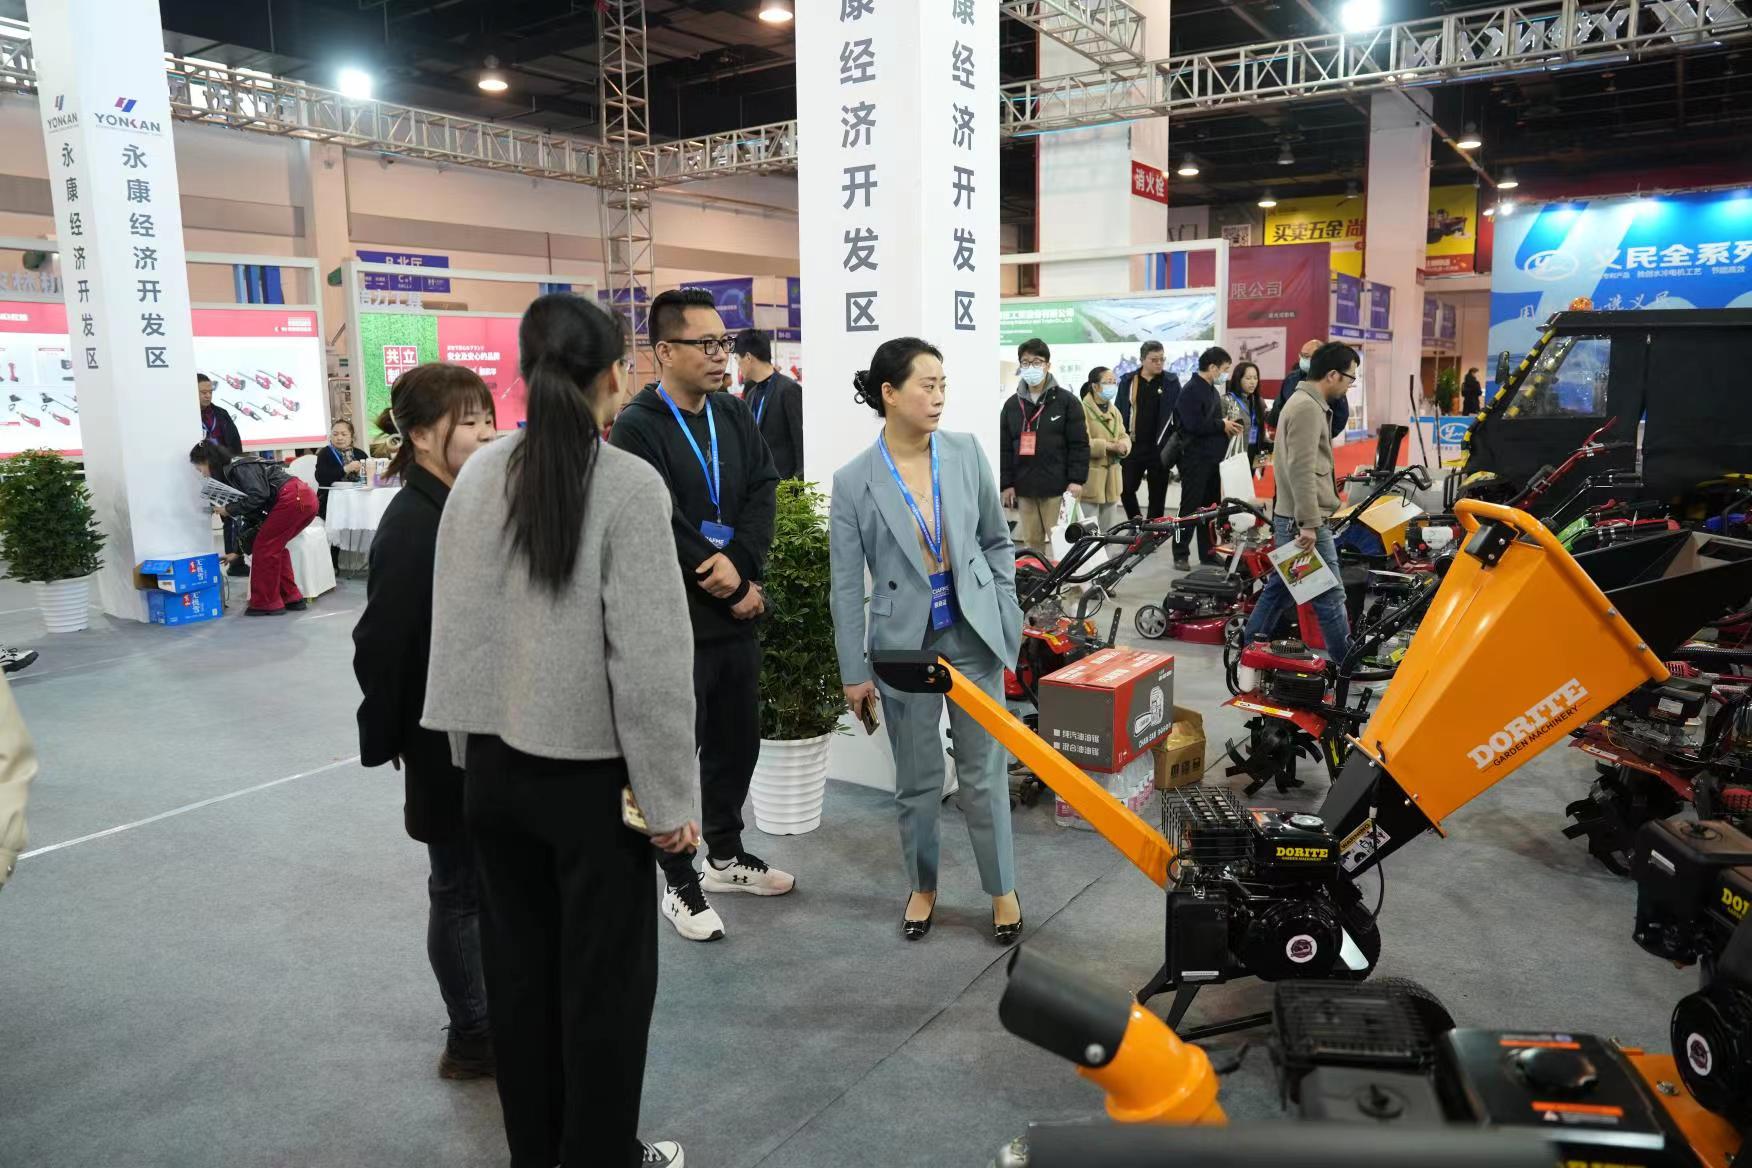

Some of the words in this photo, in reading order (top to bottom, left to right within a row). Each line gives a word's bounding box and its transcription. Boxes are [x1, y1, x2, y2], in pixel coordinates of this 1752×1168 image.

[47, 112, 78, 130] YONKAN
[94, 113, 161, 133] YONKAN
[1135, 168, 1165, 199] 消火栓
[61, 142, 99, 370] 永康经济开发区
[121, 143, 169, 369] 永康经济开发区
[386, 348, 416, 364] 共立
[1467, 678, 1588, 770] DORITE
[1493, 738, 1529, 766] GARDEN
[1529, 705, 1579, 743] MACHINERY
[1276, 847, 1328, 858] DORITE
